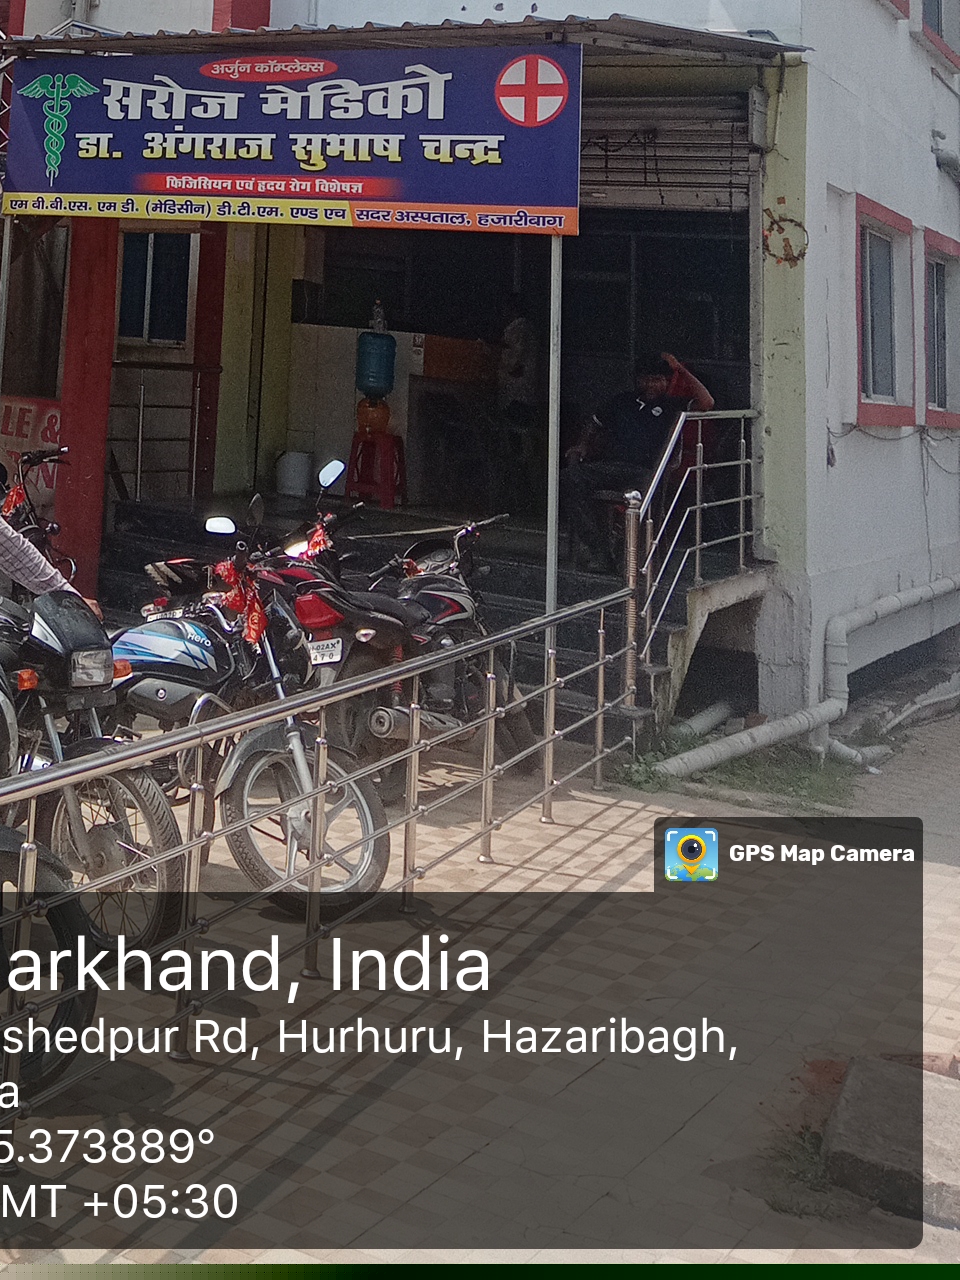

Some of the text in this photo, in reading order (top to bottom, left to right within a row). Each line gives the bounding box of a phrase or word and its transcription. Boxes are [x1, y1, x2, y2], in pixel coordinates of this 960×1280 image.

[211, 60, 325, 79] अर्जुन कॉम्प्लेक्स
[102, 64, 452, 120] सरोज मेडिको
[75, 125, 505, 171] डा. अंगराज सुभाष चन्द्र
[166, 175, 232, 191] फिजिसियन
[235, 177, 255, 190] एवं
[289, 177, 311, 192] रोग
[315, 178, 364, 194] विशेषज्ञ
[10, 199, 28, 210] एम
[97, 201, 117, 212] एम
[120, 198, 139, 213] डी.
[145, 198, 211, 218] (मेडिसीन)
[290, 206, 318, 220] एण्ड
[323, 207, 346, 220] एच
[355, 208, 392, 222] सदर
[394, 210, 471, 226] अस्पताल,
[187, 632, 212, 647] Hero
